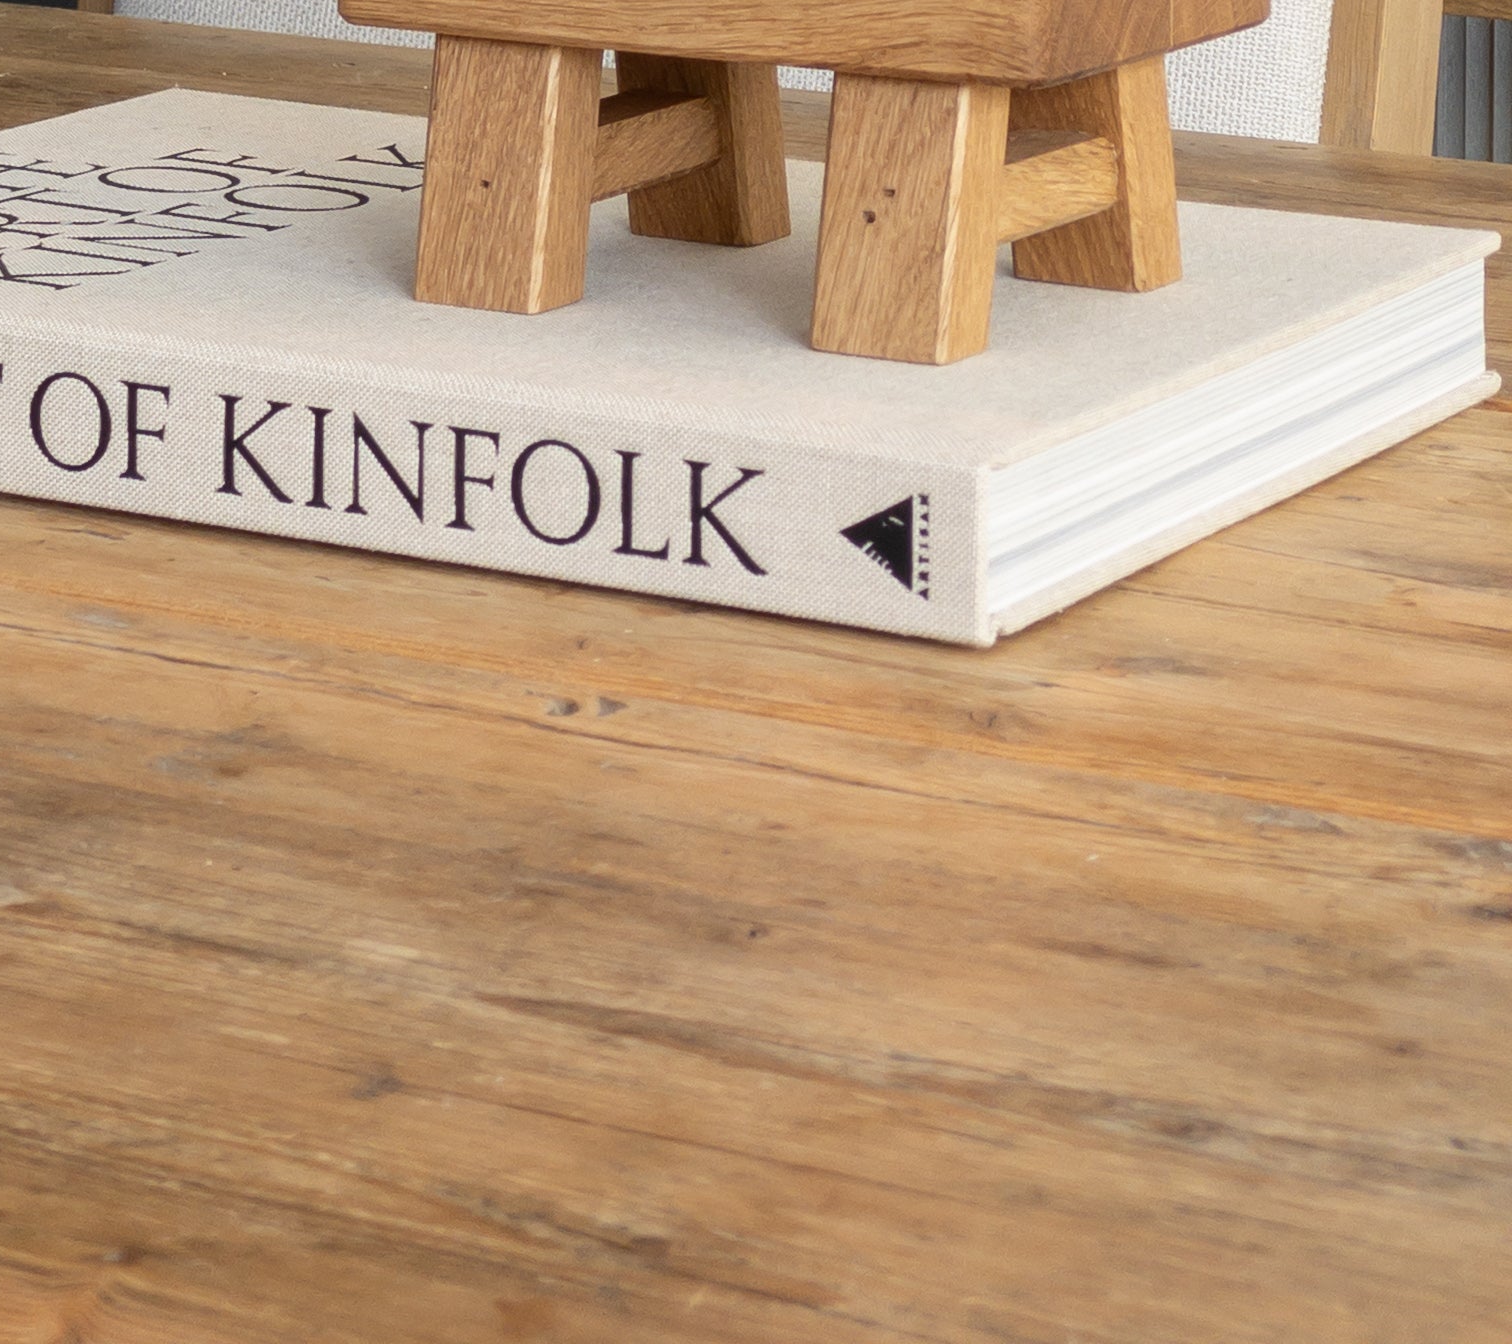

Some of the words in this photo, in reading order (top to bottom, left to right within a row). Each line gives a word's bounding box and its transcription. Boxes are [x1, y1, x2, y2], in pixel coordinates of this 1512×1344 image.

[97, 148, 294, 193] OF
[29, 370, 171, 482] OF
[215, 393, 768, 576] KINFOLK
[917, 494, 930, 600] ARTISAN
